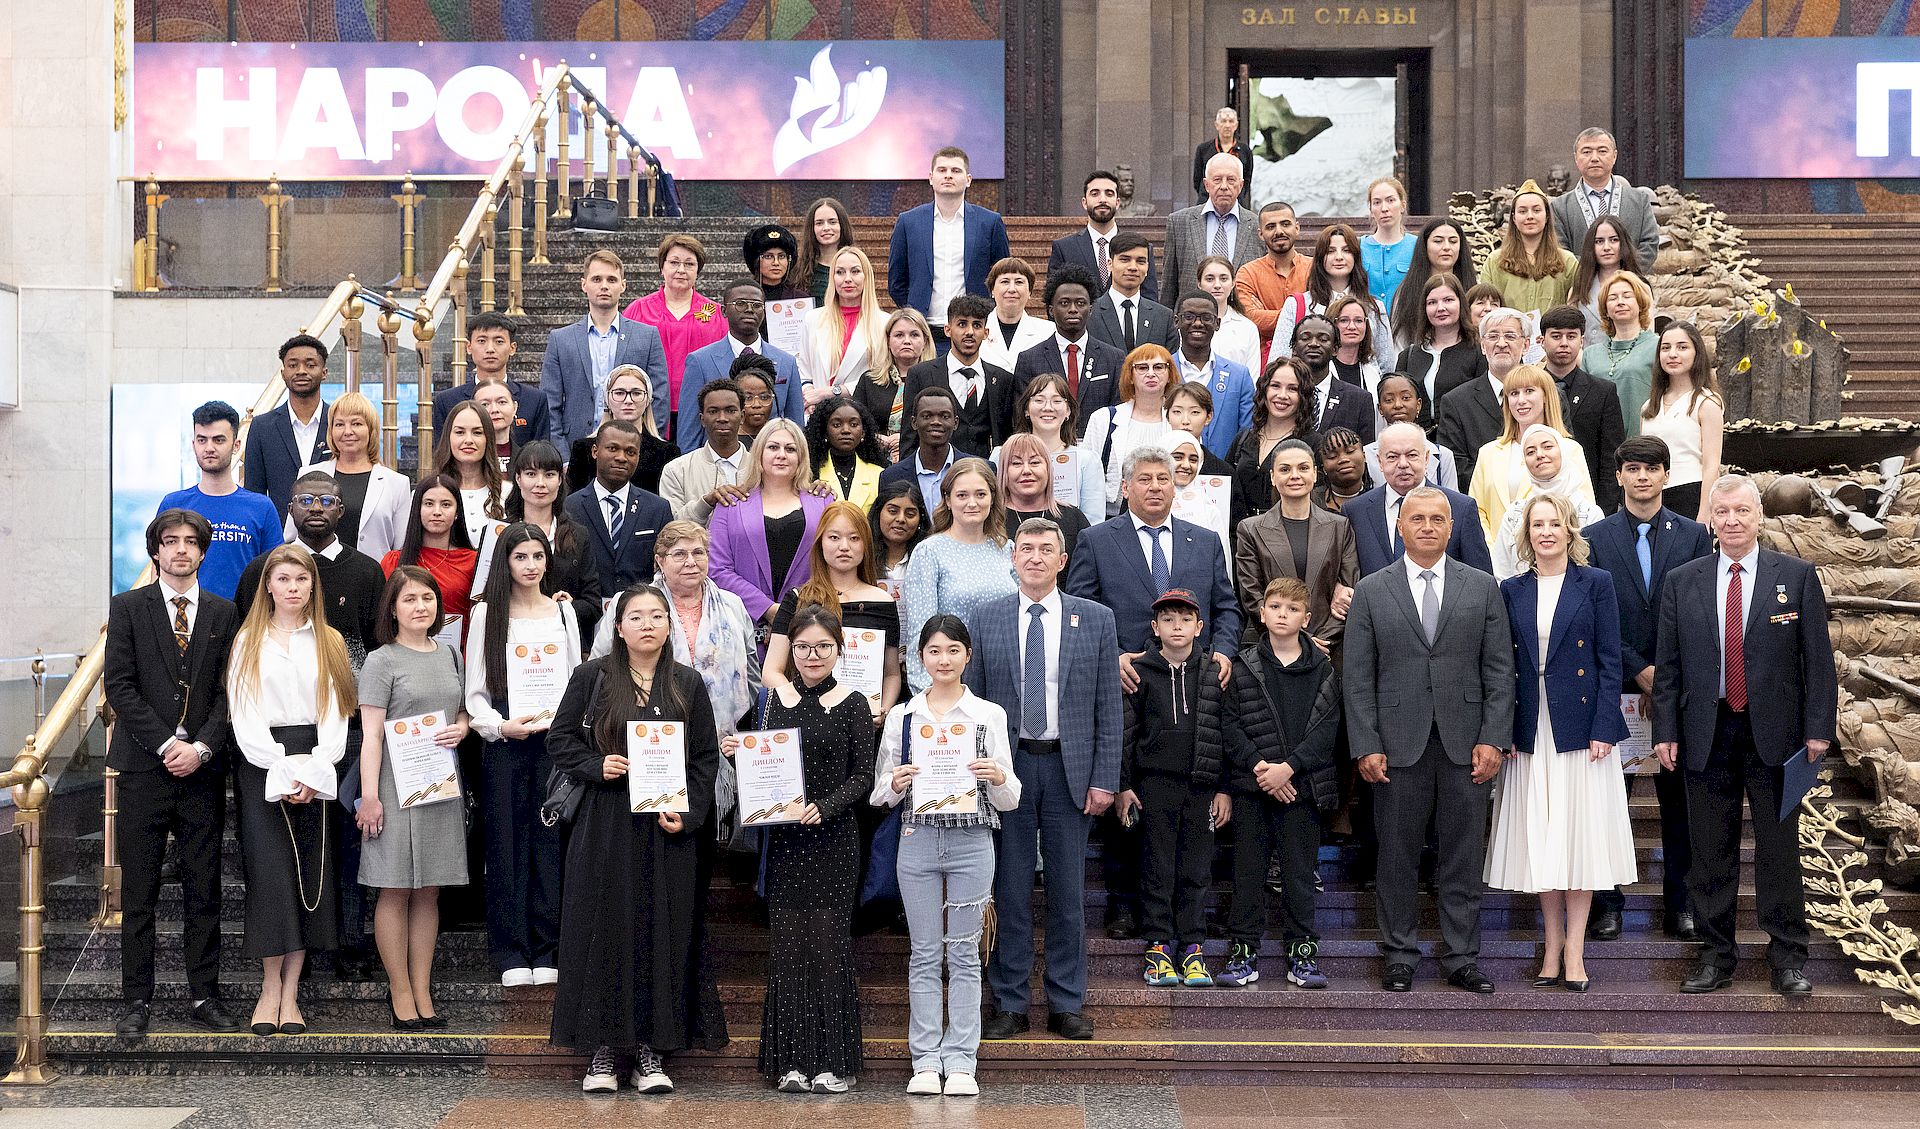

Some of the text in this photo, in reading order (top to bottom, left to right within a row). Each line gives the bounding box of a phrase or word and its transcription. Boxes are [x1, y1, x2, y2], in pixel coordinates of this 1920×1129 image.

[1241, 7, 1417, 26] ЗАЛ СЛАВЫ
[196, 65, 704, 173] НАРОДА
[220, 521, 240, 530] than
[211, 530, 252, 544] ERSITY
[522, 667, 554, 676] ДИПЛОМ
[641, 748, 671, 756] ДИПЛОМ
[927, 749, 961, 757] ДИПЛОМ
[751, 757, 785, 767] ДИПЛОМ
